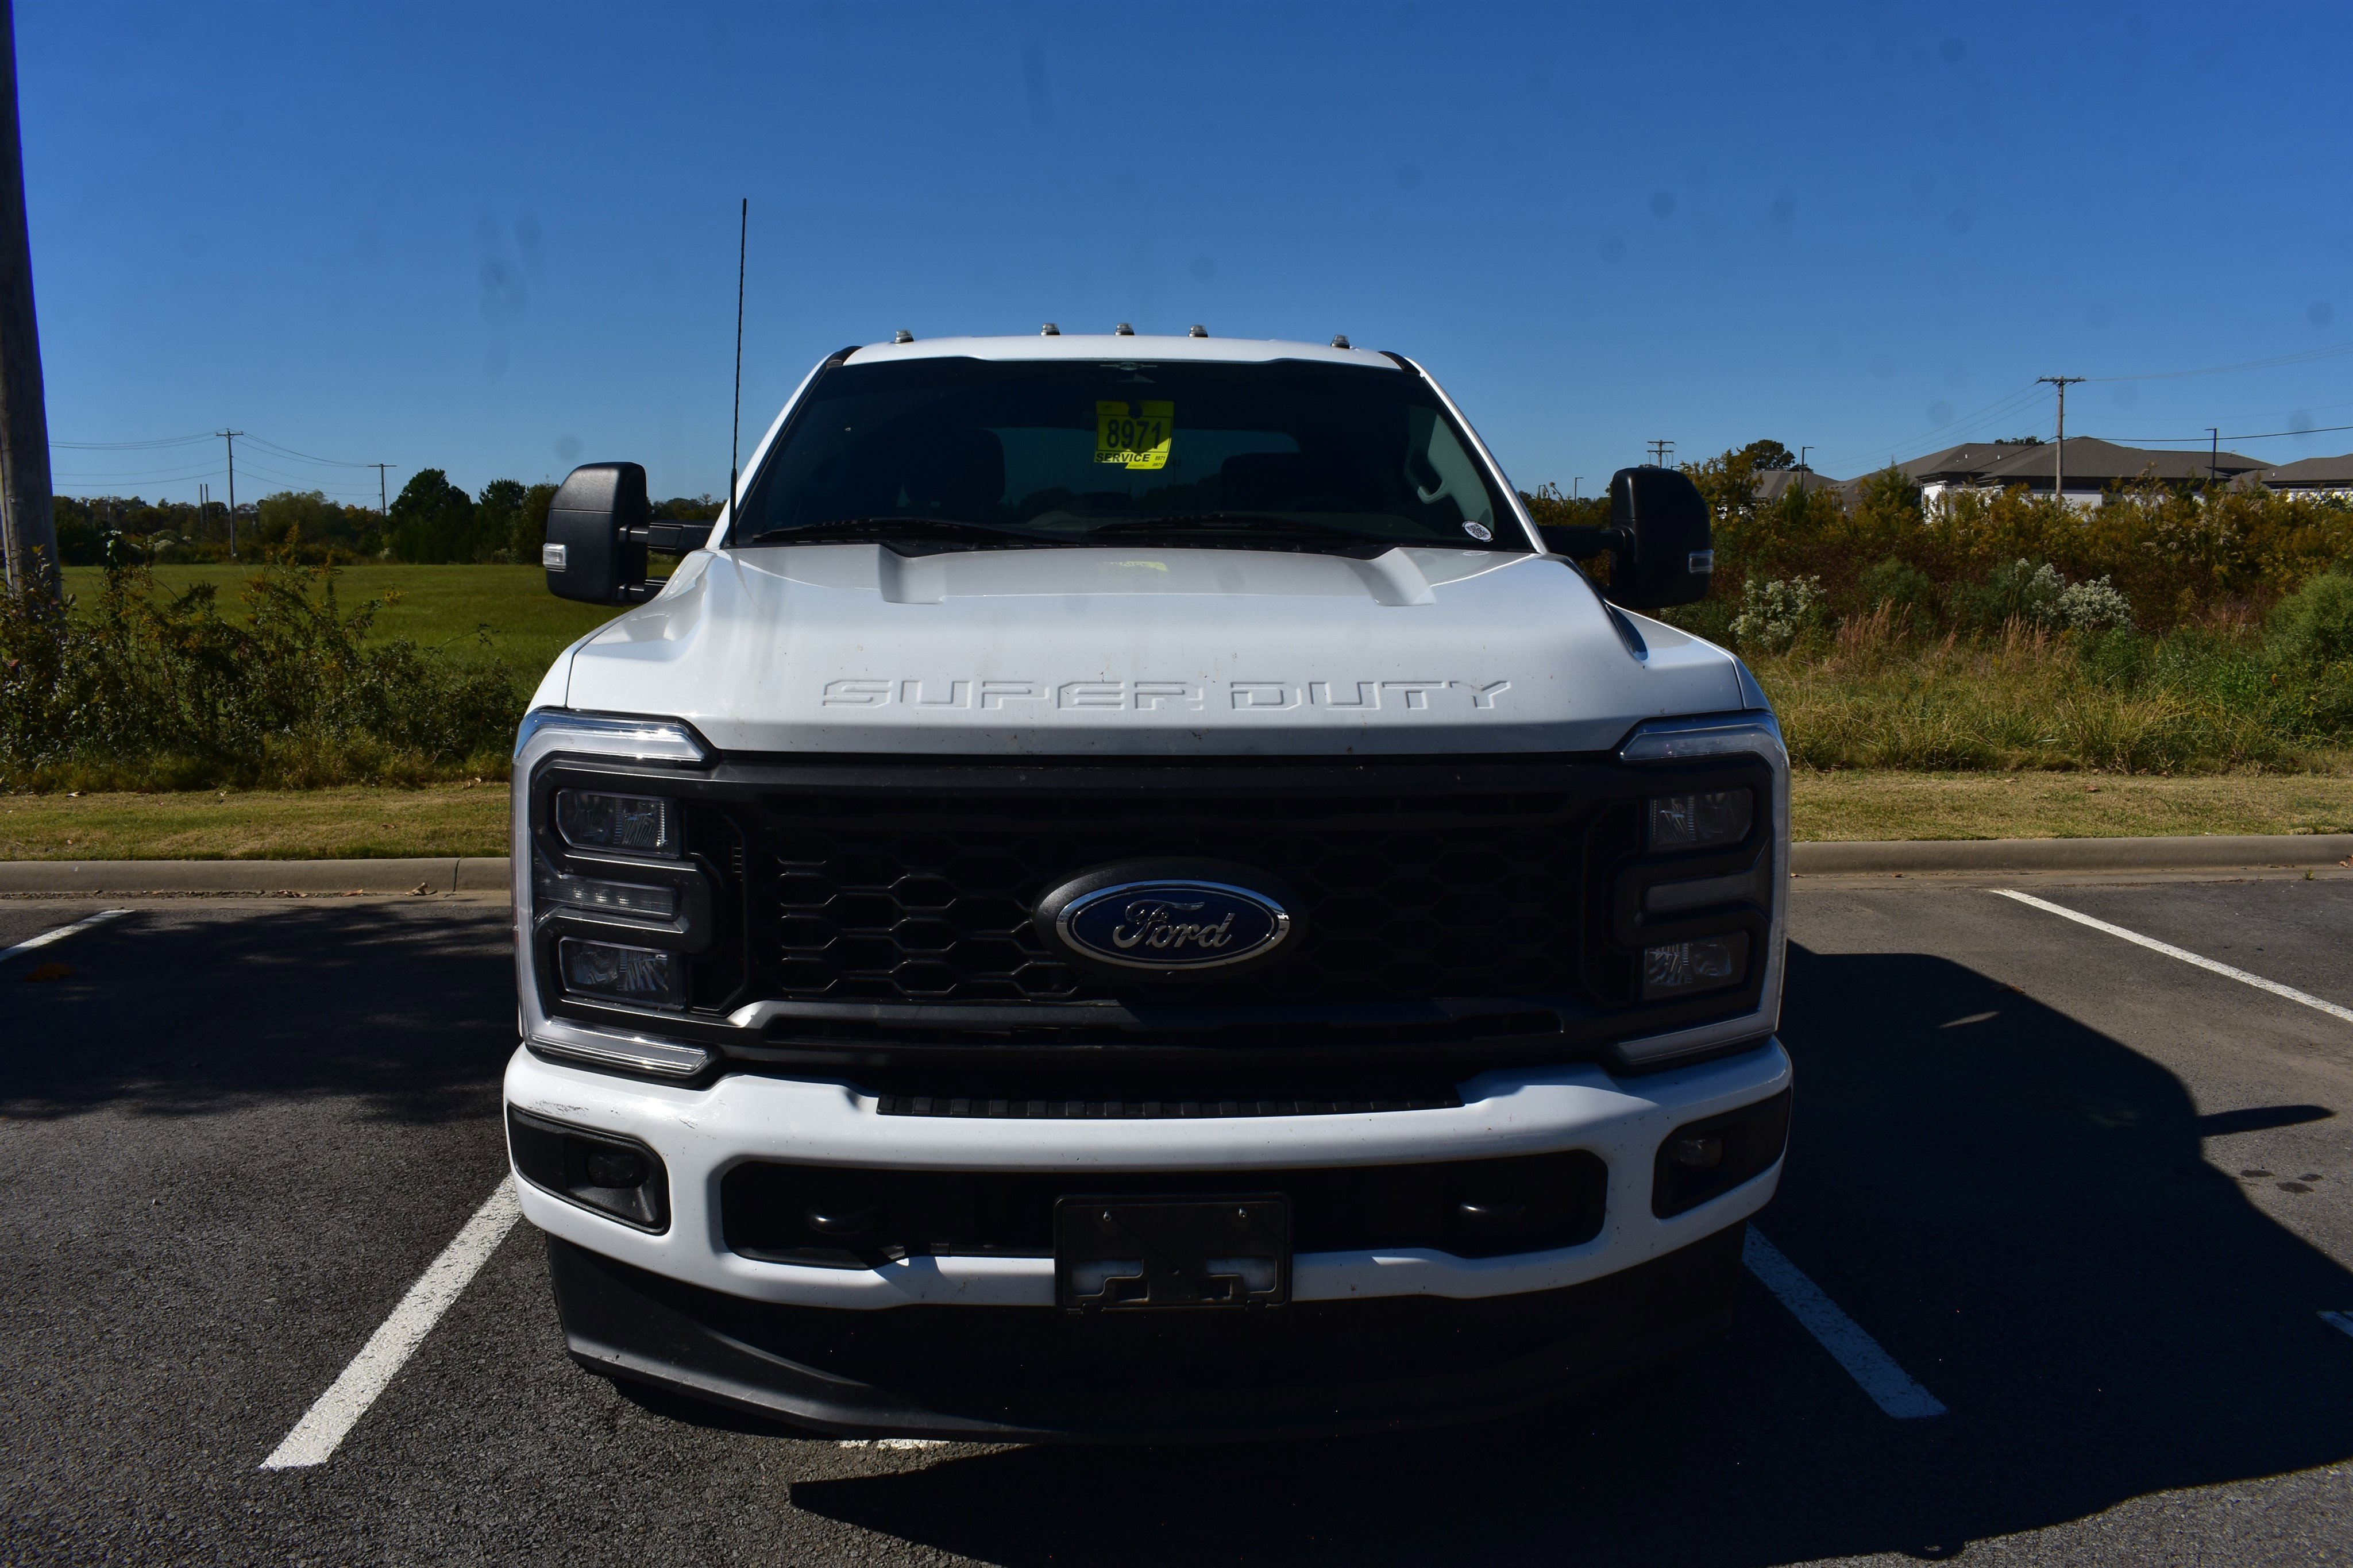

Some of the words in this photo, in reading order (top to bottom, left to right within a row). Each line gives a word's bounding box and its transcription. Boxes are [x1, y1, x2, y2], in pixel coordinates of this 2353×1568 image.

[1106, 419, 1162, 449] 8971
[1096, 453, 1151, 462] SERVICE
[822, 679, 1205, 710] SUPER
[1230, 681, 1511, 710] DUTY
[1112, 899, 1236, 948] Ford
